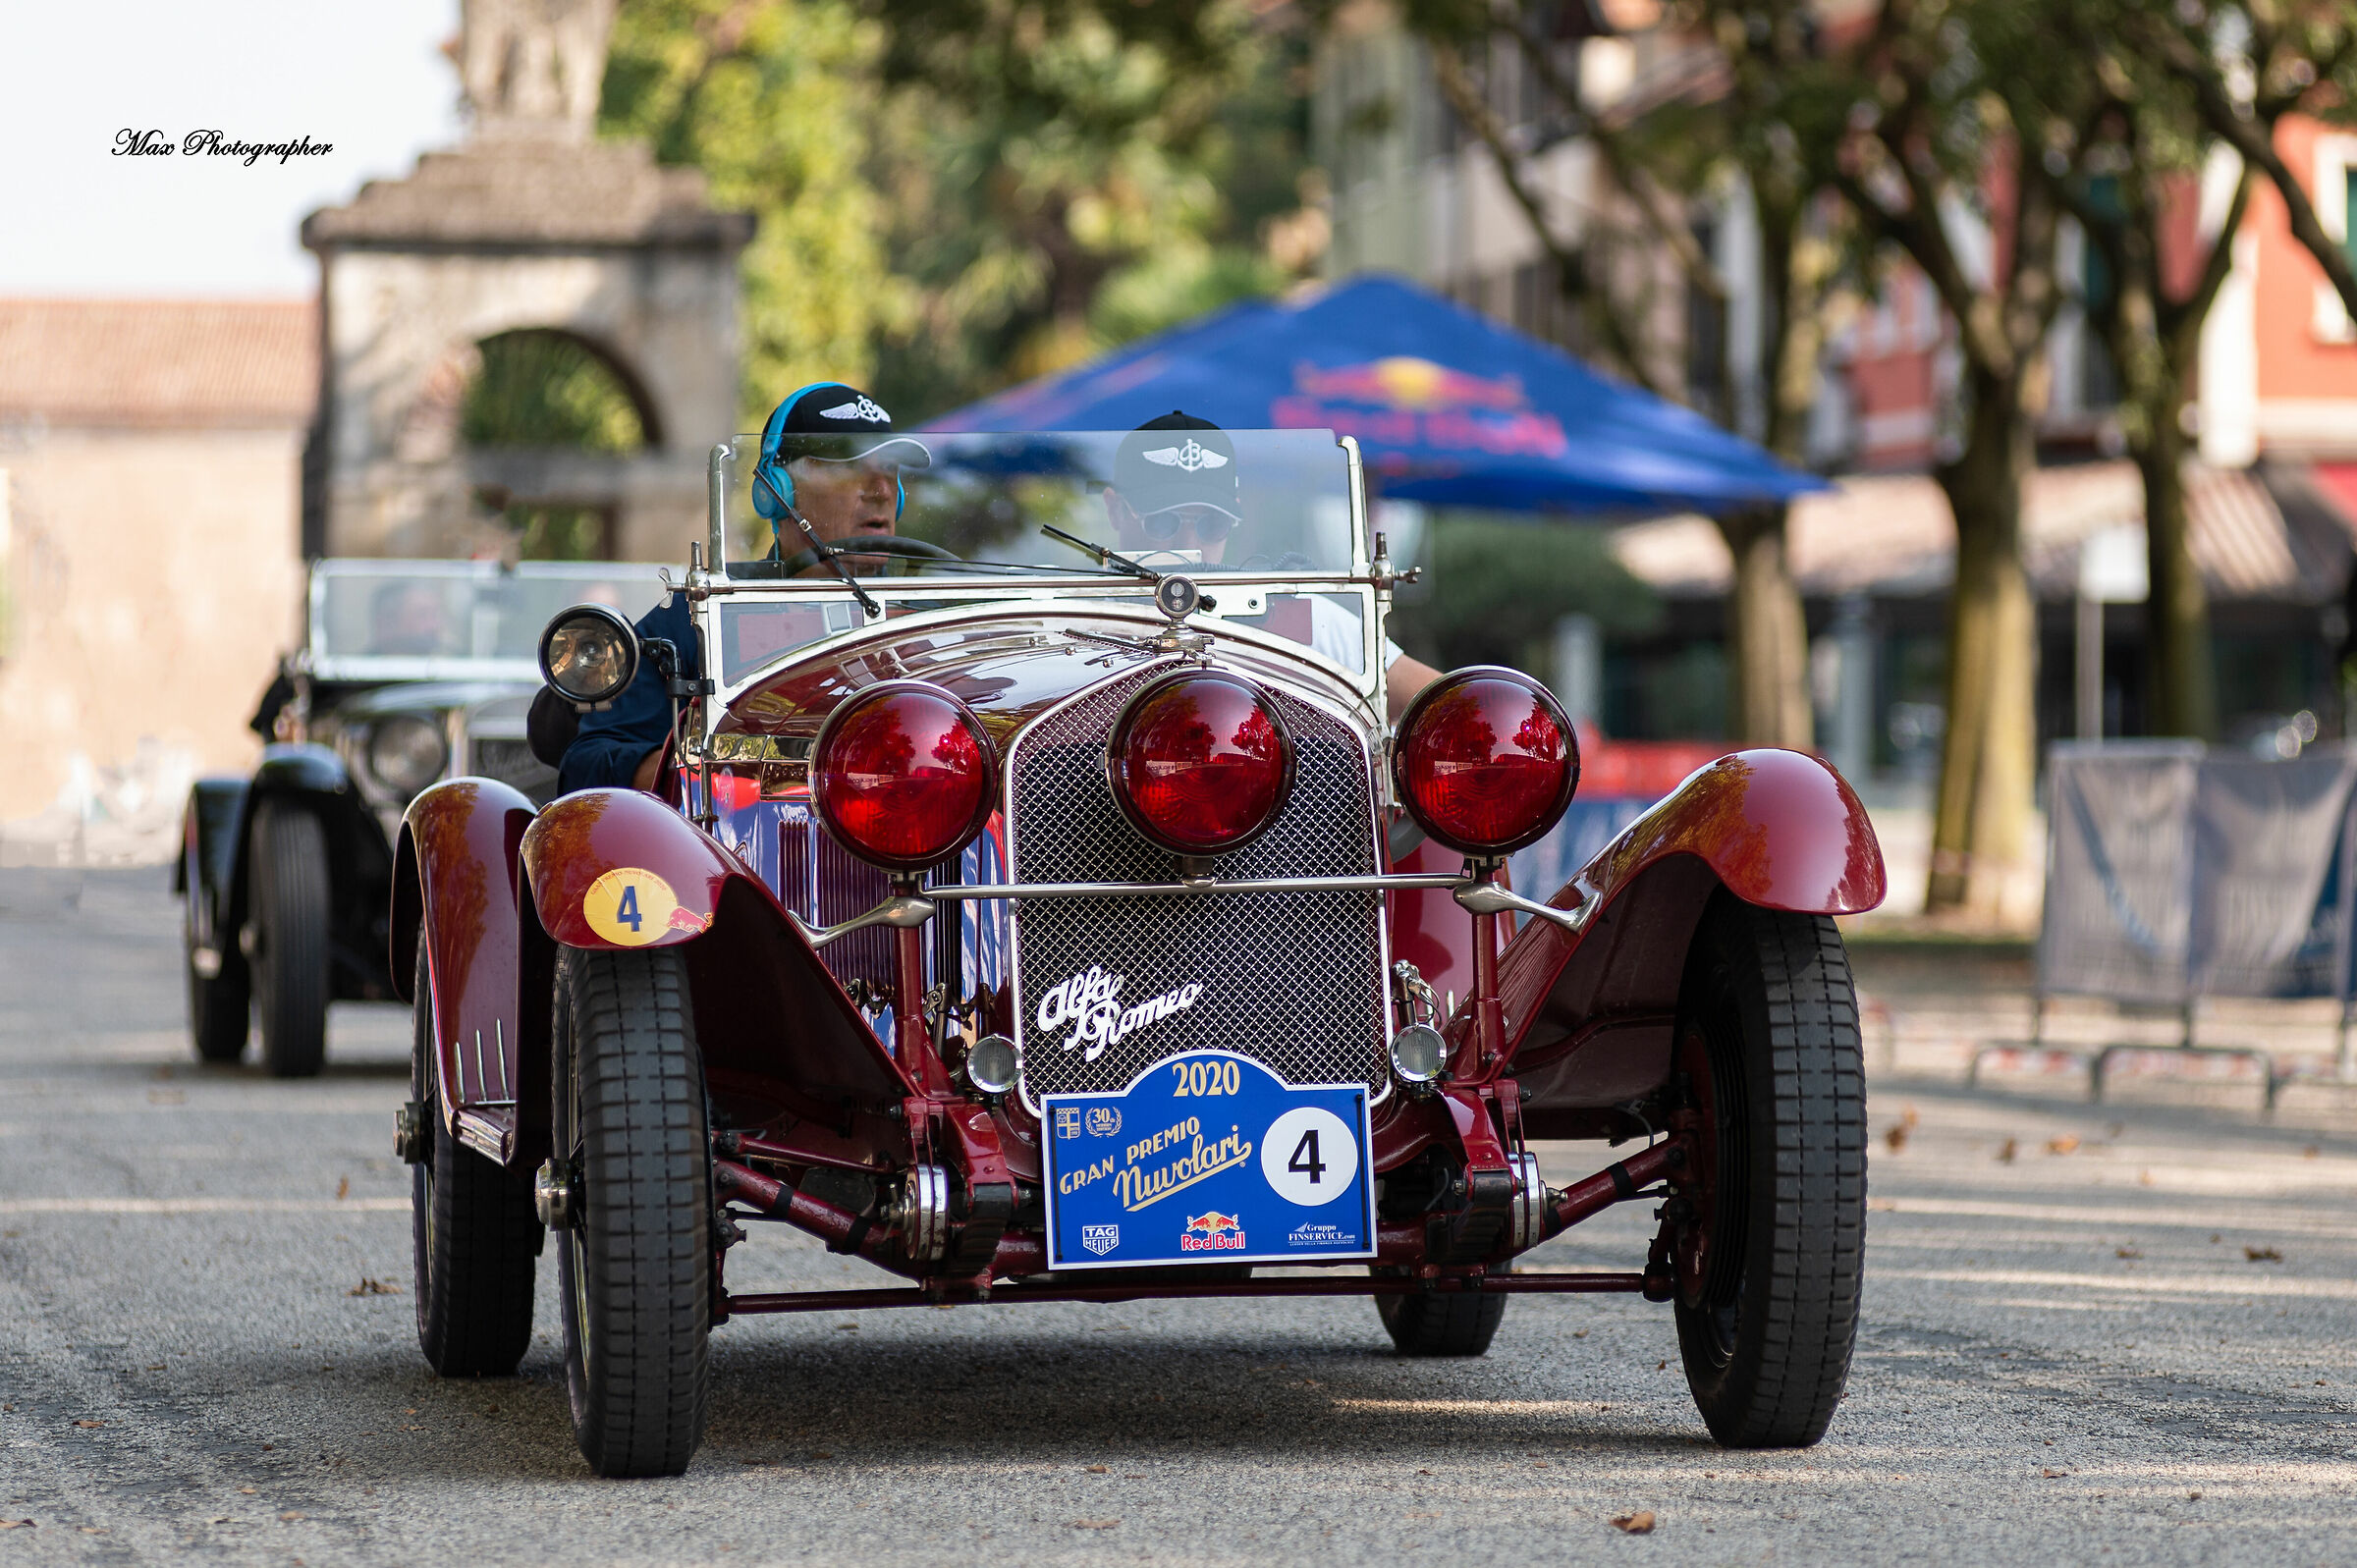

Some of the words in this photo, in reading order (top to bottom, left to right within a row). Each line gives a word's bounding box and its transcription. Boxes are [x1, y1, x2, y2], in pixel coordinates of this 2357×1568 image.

[617, 886, 642, 932] 4
[1037, 965, 1124, 1052] Alfa
[1080, 982, 1203, 1062] Romeo
[1173, 1060, 1240, 1098] 2020
[1059, 1155, 1115, 1195] GRAN
[1126, 1116, 1200, 1165] PREMIO
[1113, 1124, 1252, 1210] Nuvolari
[1288, 1129, 1327, 1184] 4
[1085, 1227, 1116, 1237] TAG
[1085, 1238, 1117, 1253] HEUER
[1180, 1233, 1213, 1251] Red
[1215, 1232, 1246, 1249] Bull
